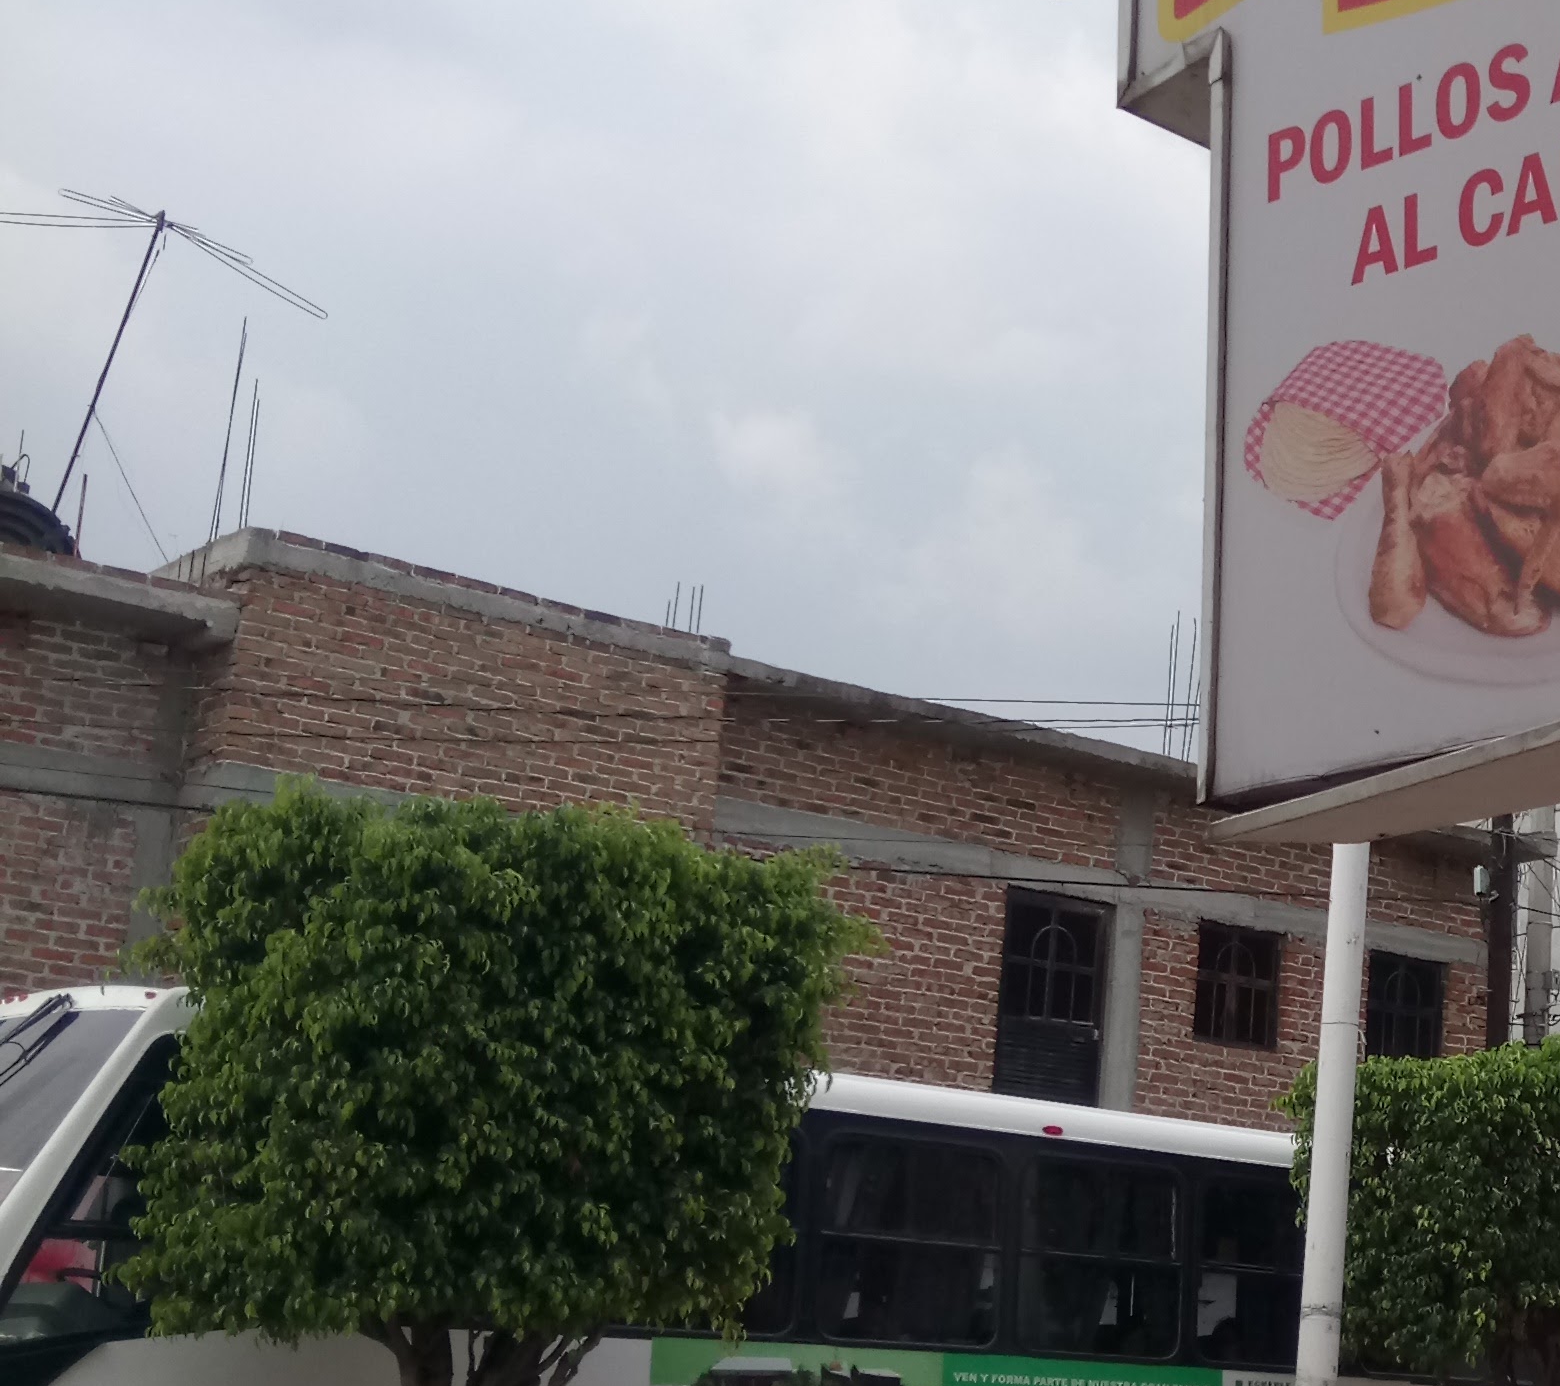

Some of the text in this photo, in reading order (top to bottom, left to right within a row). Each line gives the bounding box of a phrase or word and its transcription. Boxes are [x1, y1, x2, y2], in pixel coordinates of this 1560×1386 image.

[1266, 43, 1531, 205] POLLOS
[1350, 204, 1439, 287] AL
[953, 1371, 978, 1384] VEN
[980, 1373, 989, 1383] Y
[991, 1373, 1031, 1386] FORMA
